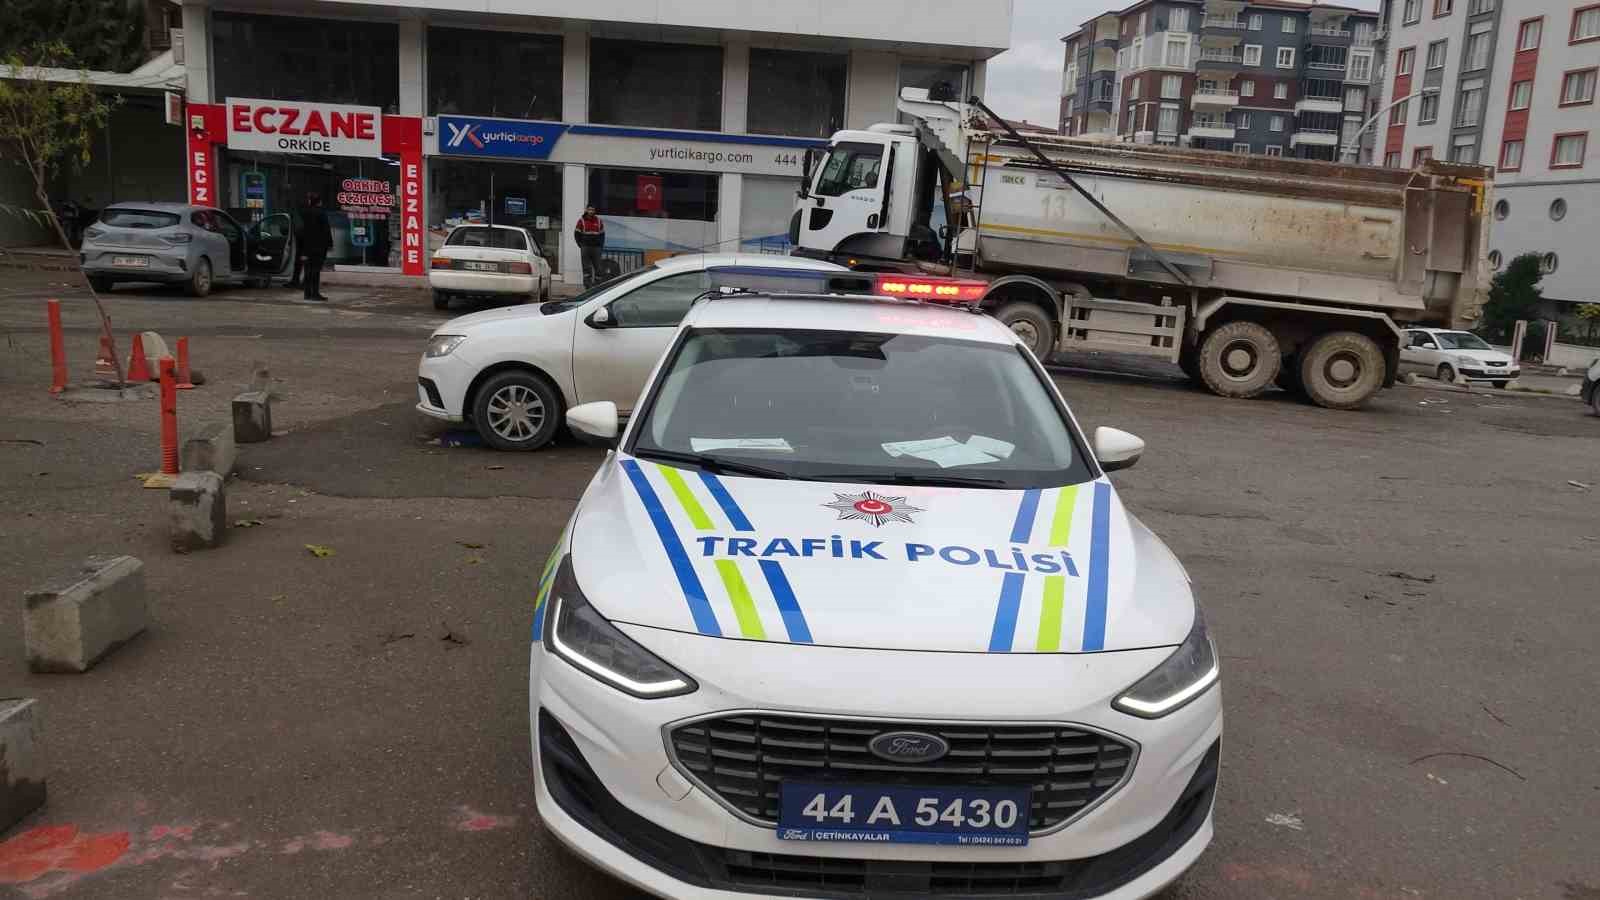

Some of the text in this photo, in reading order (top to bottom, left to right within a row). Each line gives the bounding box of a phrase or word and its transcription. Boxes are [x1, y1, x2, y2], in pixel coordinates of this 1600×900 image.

[232, 104, 376, 140] ECZANE
[278, 136, 331, 152] ORKİDE
[650, 147, 797, 167] yurticikargo.com 444
[194, 151, 208, 202] ECZ
[406, 164, 419, 264] ECZANE
[696, 534, 1080, 577] TRAFİK POLİSİ
[887, 737, 930, 754] Ford
[802, 793, 1018, 829] 44 A 5430
[783, 828, 809, 841] Ford
